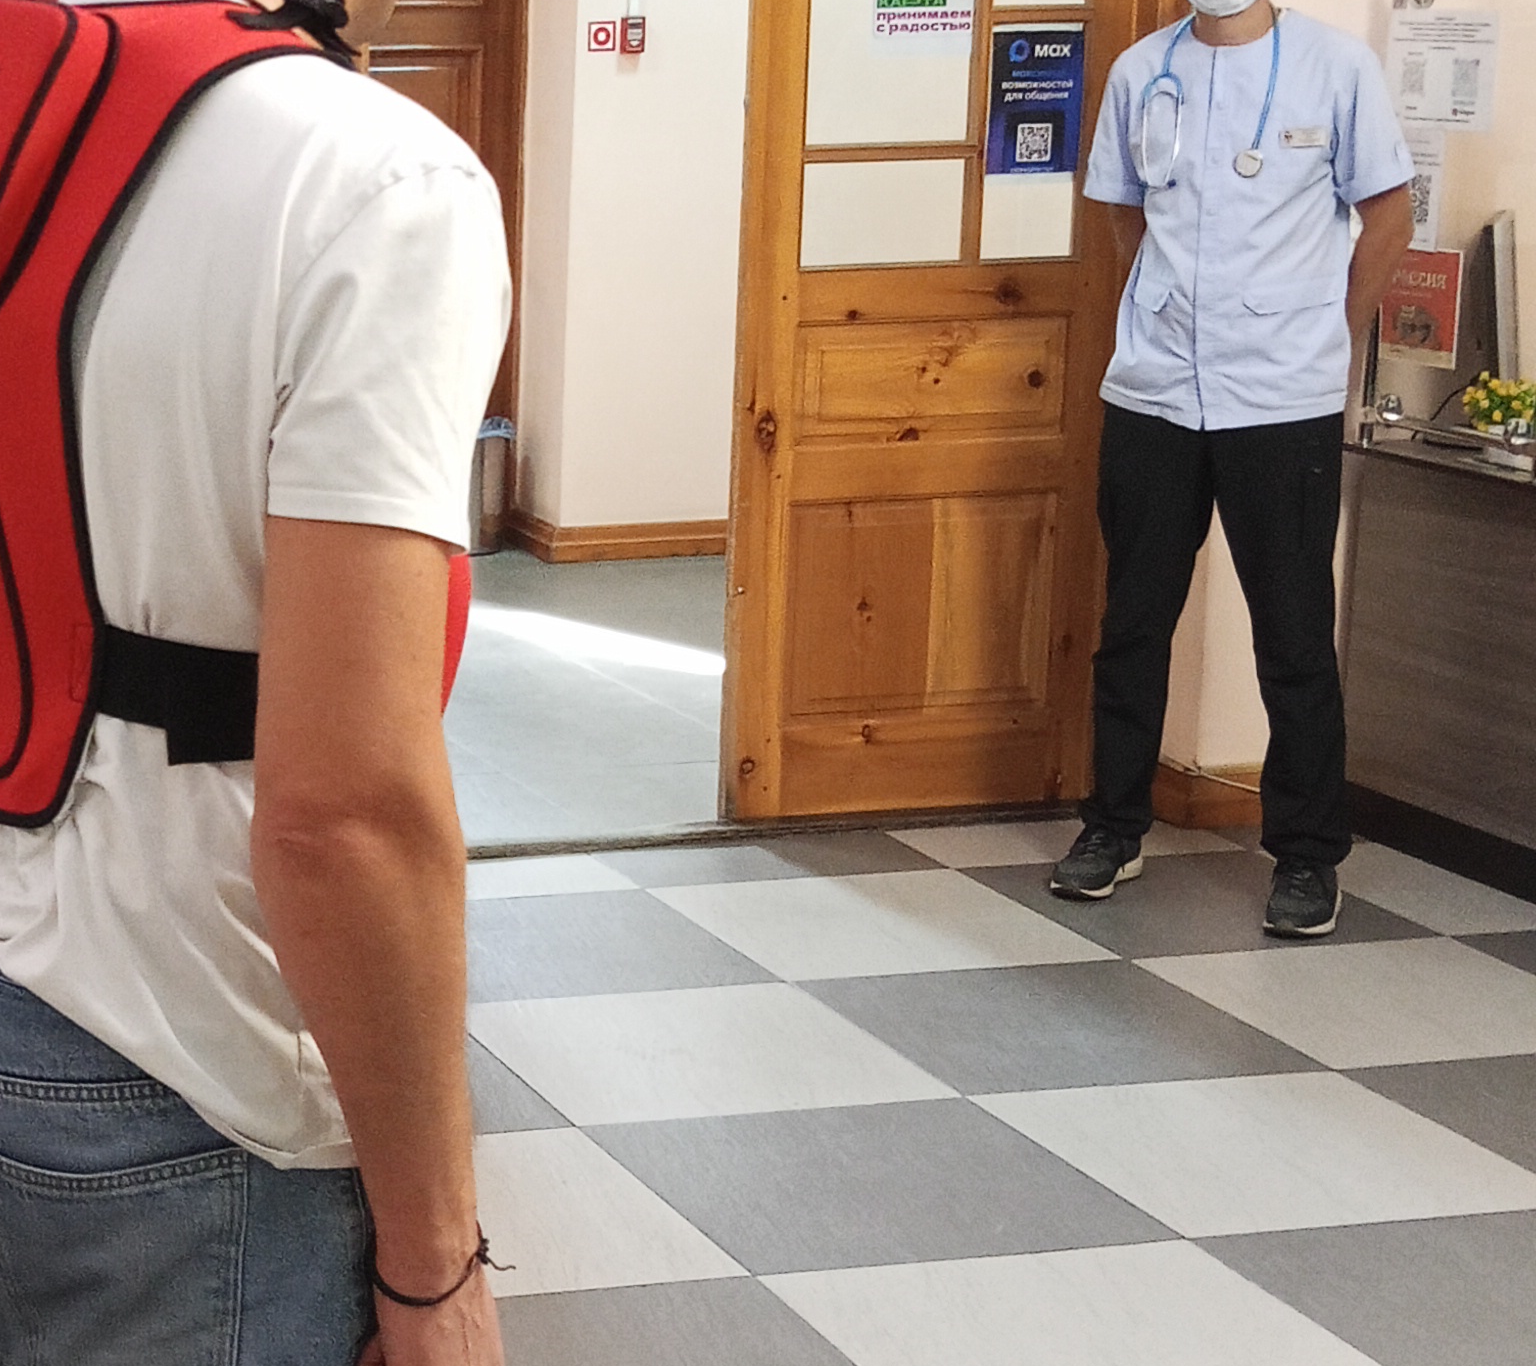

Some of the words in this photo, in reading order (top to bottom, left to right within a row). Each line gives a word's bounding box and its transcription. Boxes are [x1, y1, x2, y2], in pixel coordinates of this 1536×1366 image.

[876, 10, 972, 23] принимаем
[876, 23, 886, 33] с
[889, 21, 972, 35] радостью
[1001, 79, 1073, 90] возможностей
[1004, 92, 1024, 103] для
[1025, 91, 1070, 101] общения
